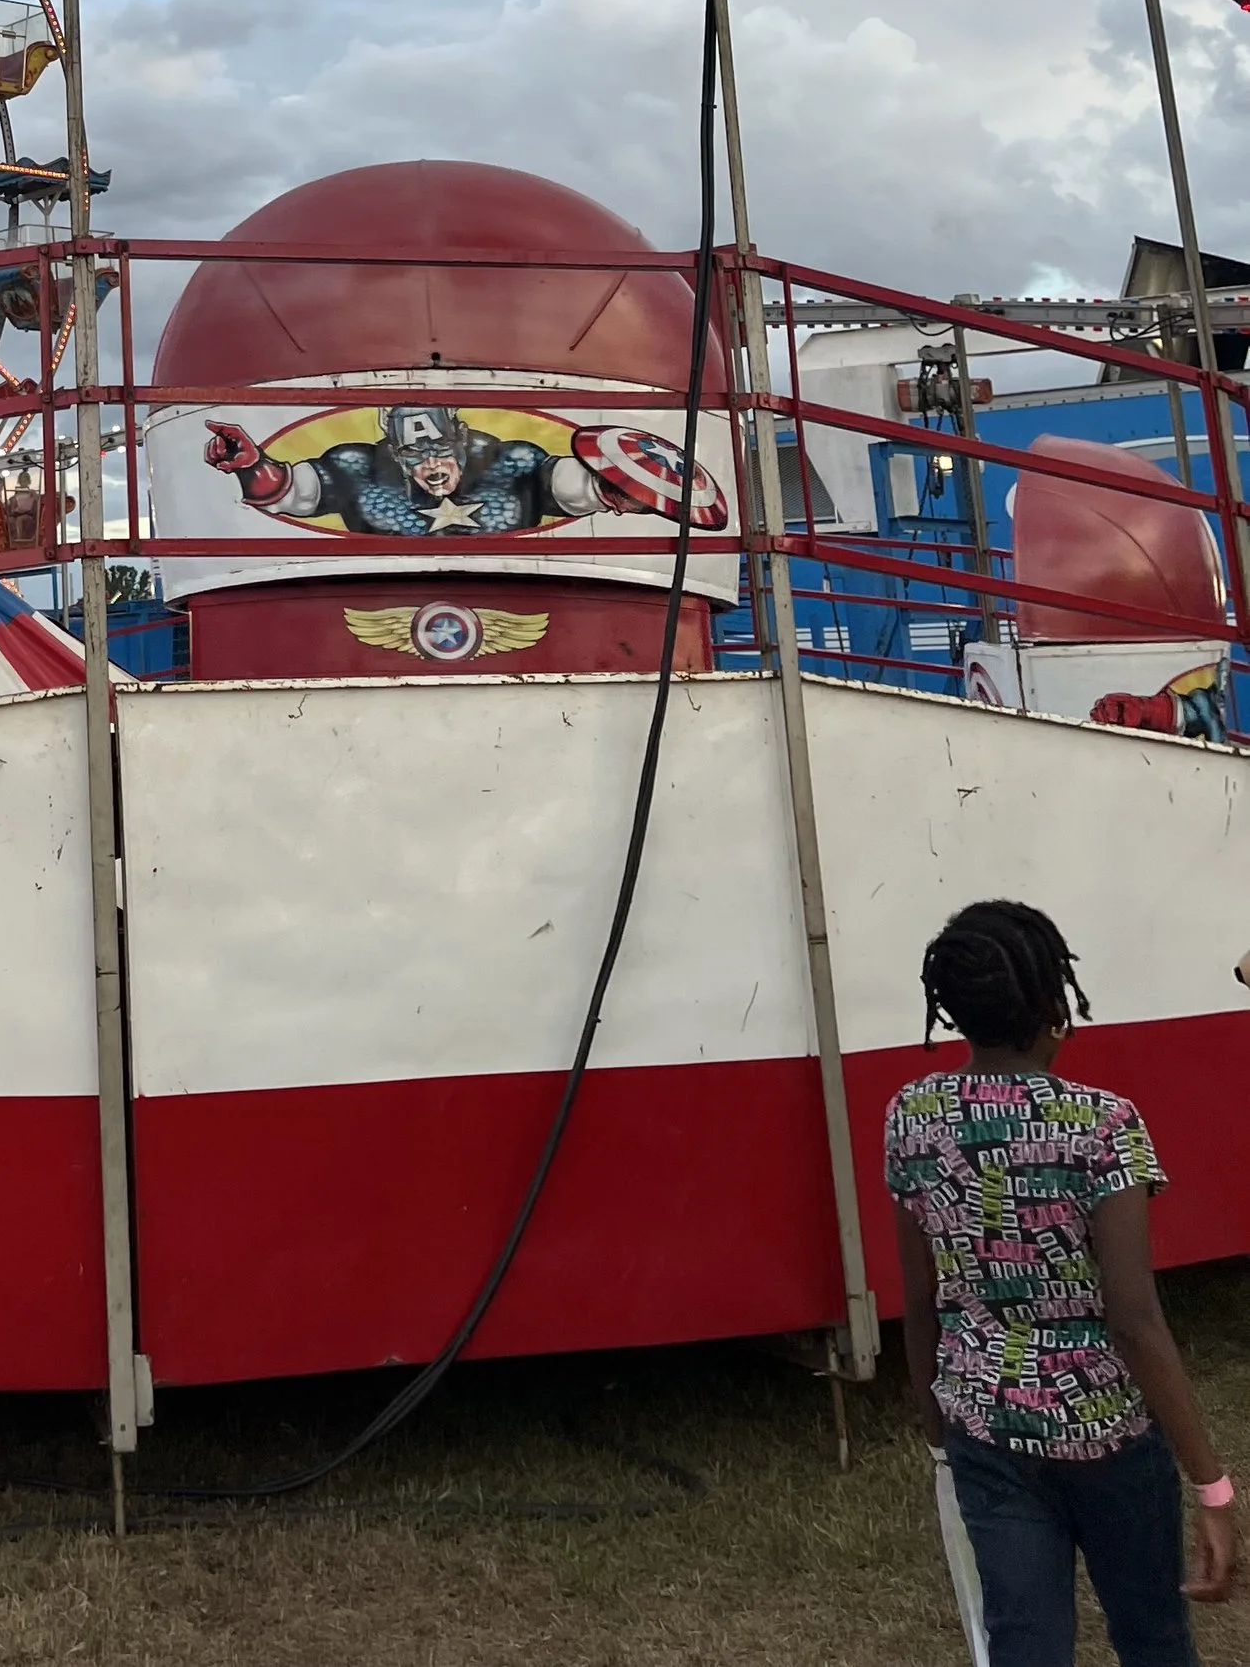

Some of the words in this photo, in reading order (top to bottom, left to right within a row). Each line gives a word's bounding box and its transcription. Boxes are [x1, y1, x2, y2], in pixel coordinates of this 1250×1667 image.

[403, 413, 443, 446] A
[961, 1081, 1031, 1105] LOVE
[980, 1162, 1007, 1231] LOVE
[975, 1238, 1041, 1265] LOVE
